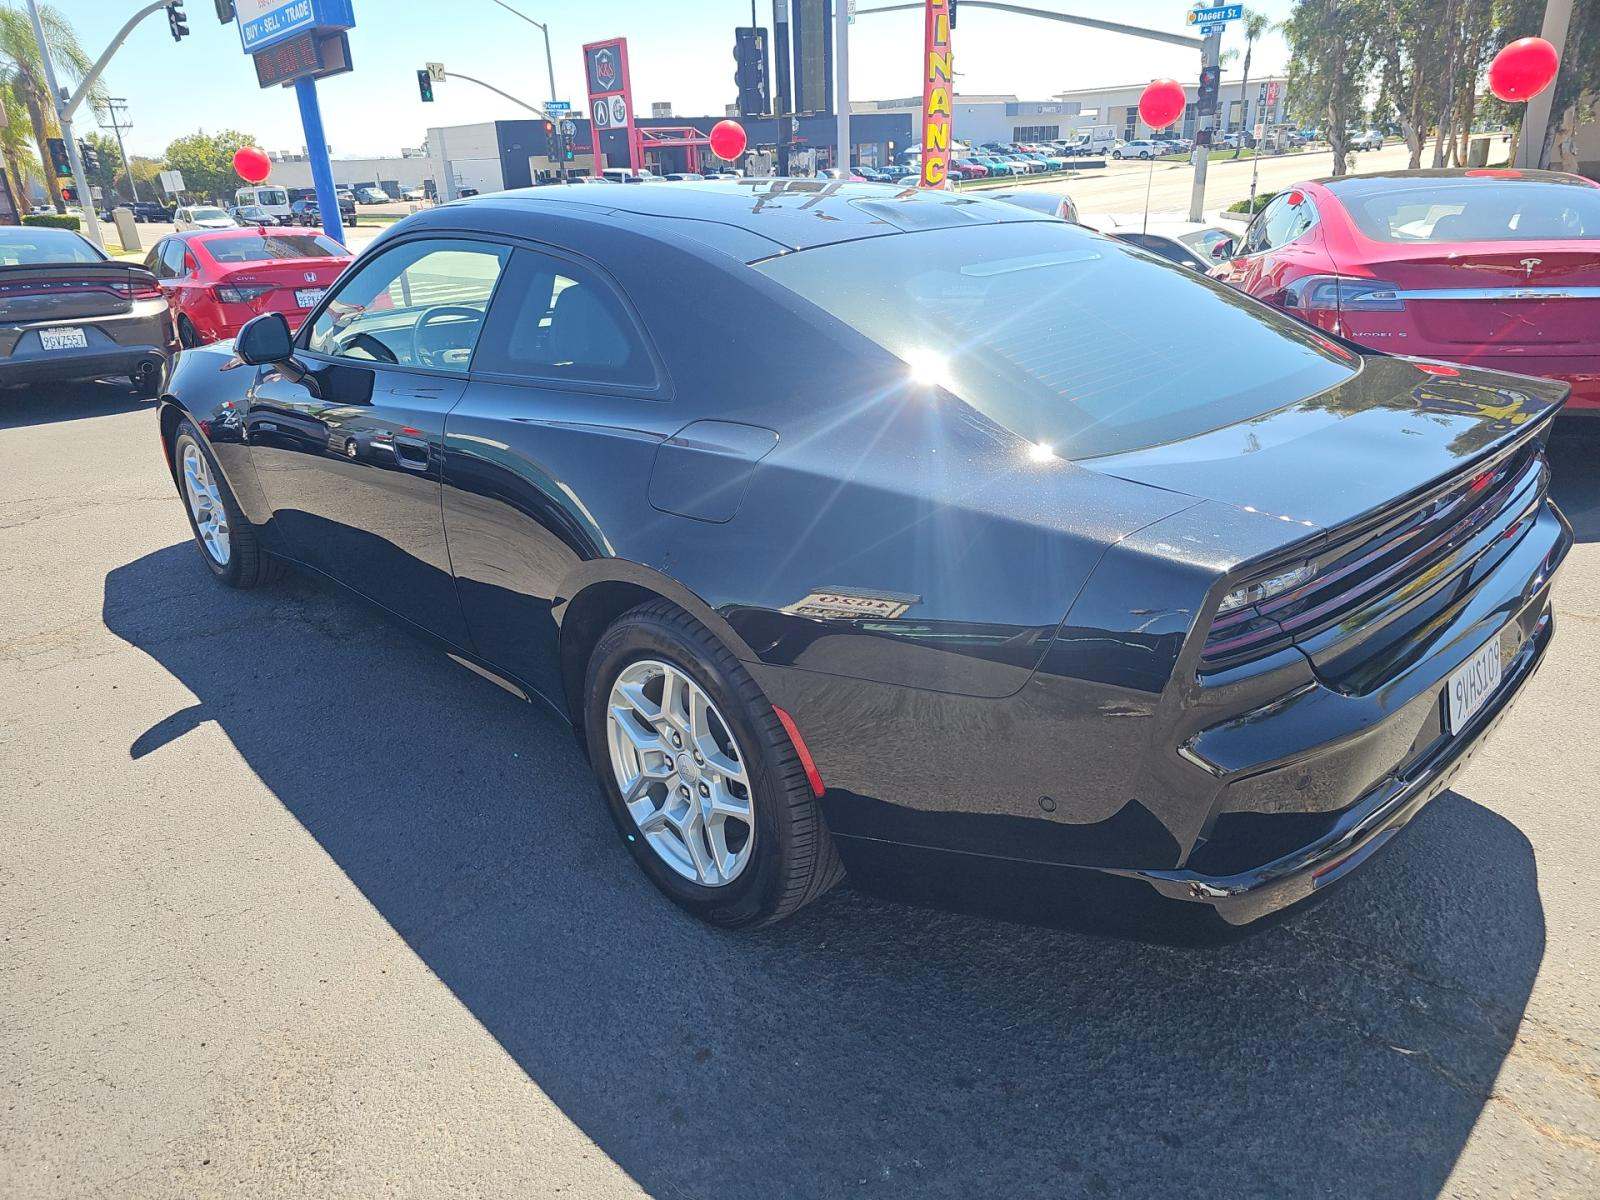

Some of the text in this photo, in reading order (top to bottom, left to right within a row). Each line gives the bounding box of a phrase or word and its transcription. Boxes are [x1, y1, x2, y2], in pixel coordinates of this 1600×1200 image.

[245, 23, 259, 41] BUY
[263, 14, 281, 33] SELL
[285, 1, 310, 23] TRADE
[1197, 11, 1226, 22] DAGGET
